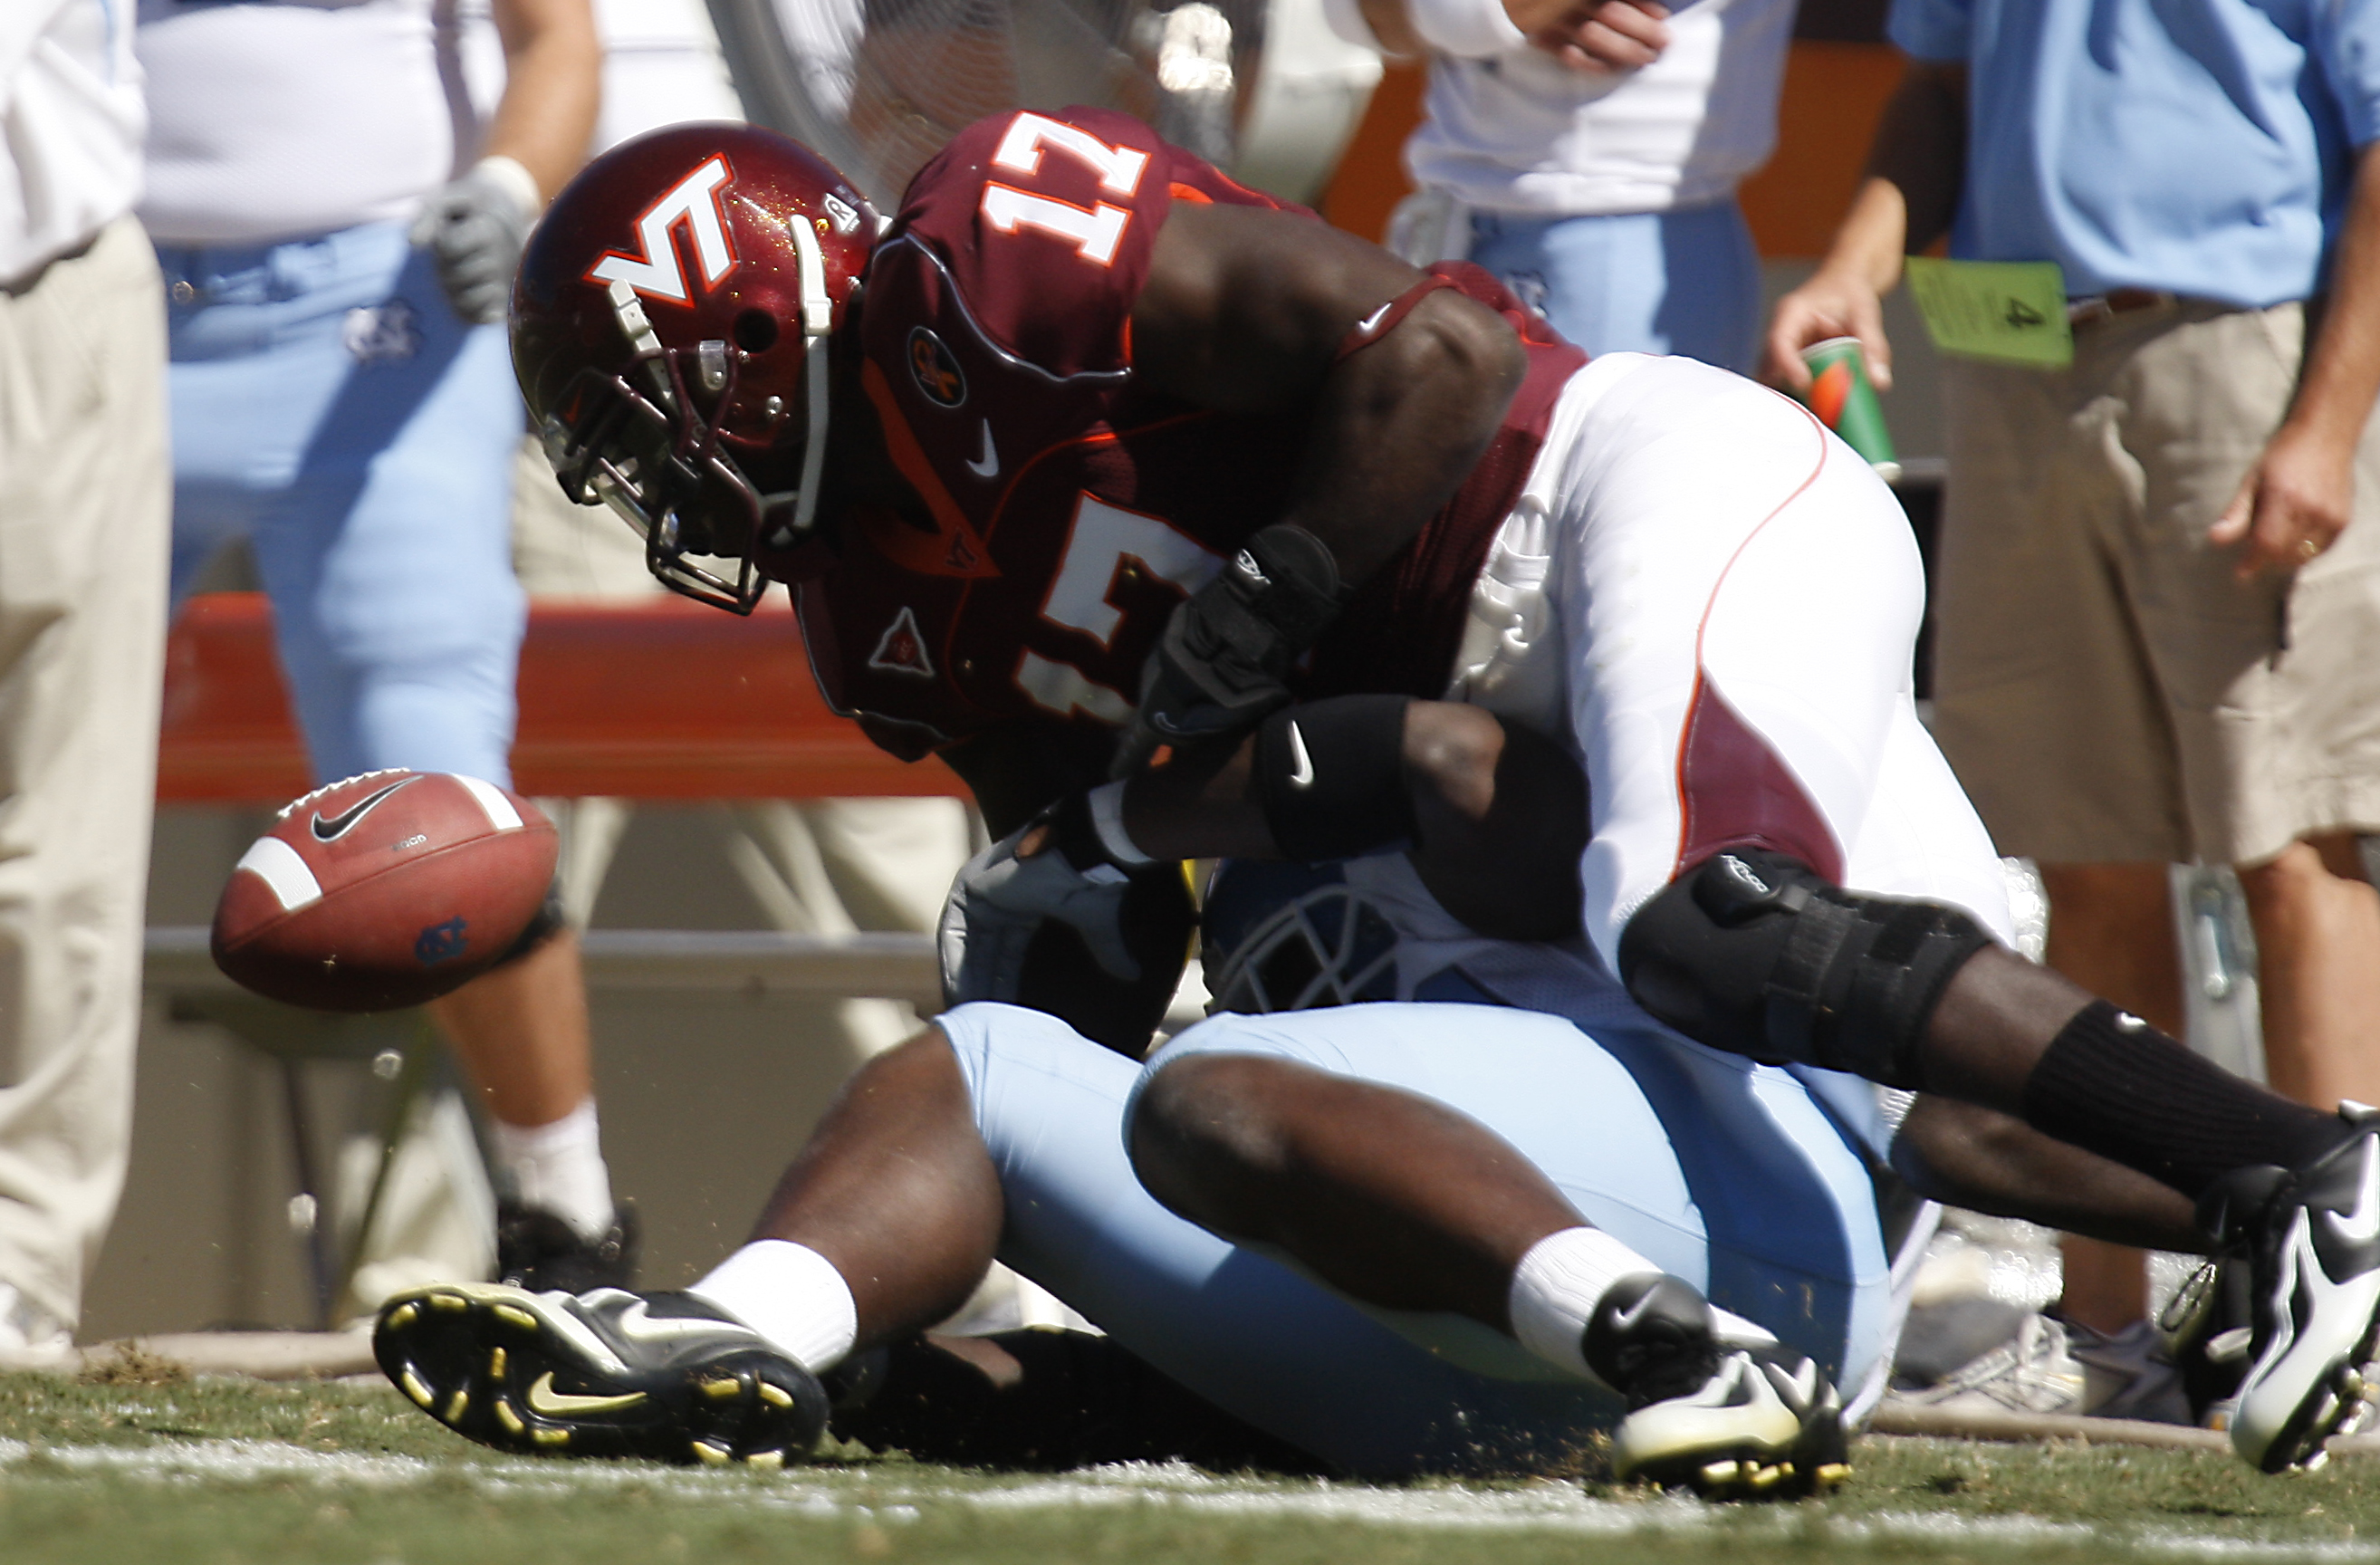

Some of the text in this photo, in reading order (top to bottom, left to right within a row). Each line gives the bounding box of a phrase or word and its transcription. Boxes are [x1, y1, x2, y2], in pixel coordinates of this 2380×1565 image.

[583, 152, 739, 308] VT
[980, 110, 1151, 267] 17
[2006, 294, 2046, 331] 4
